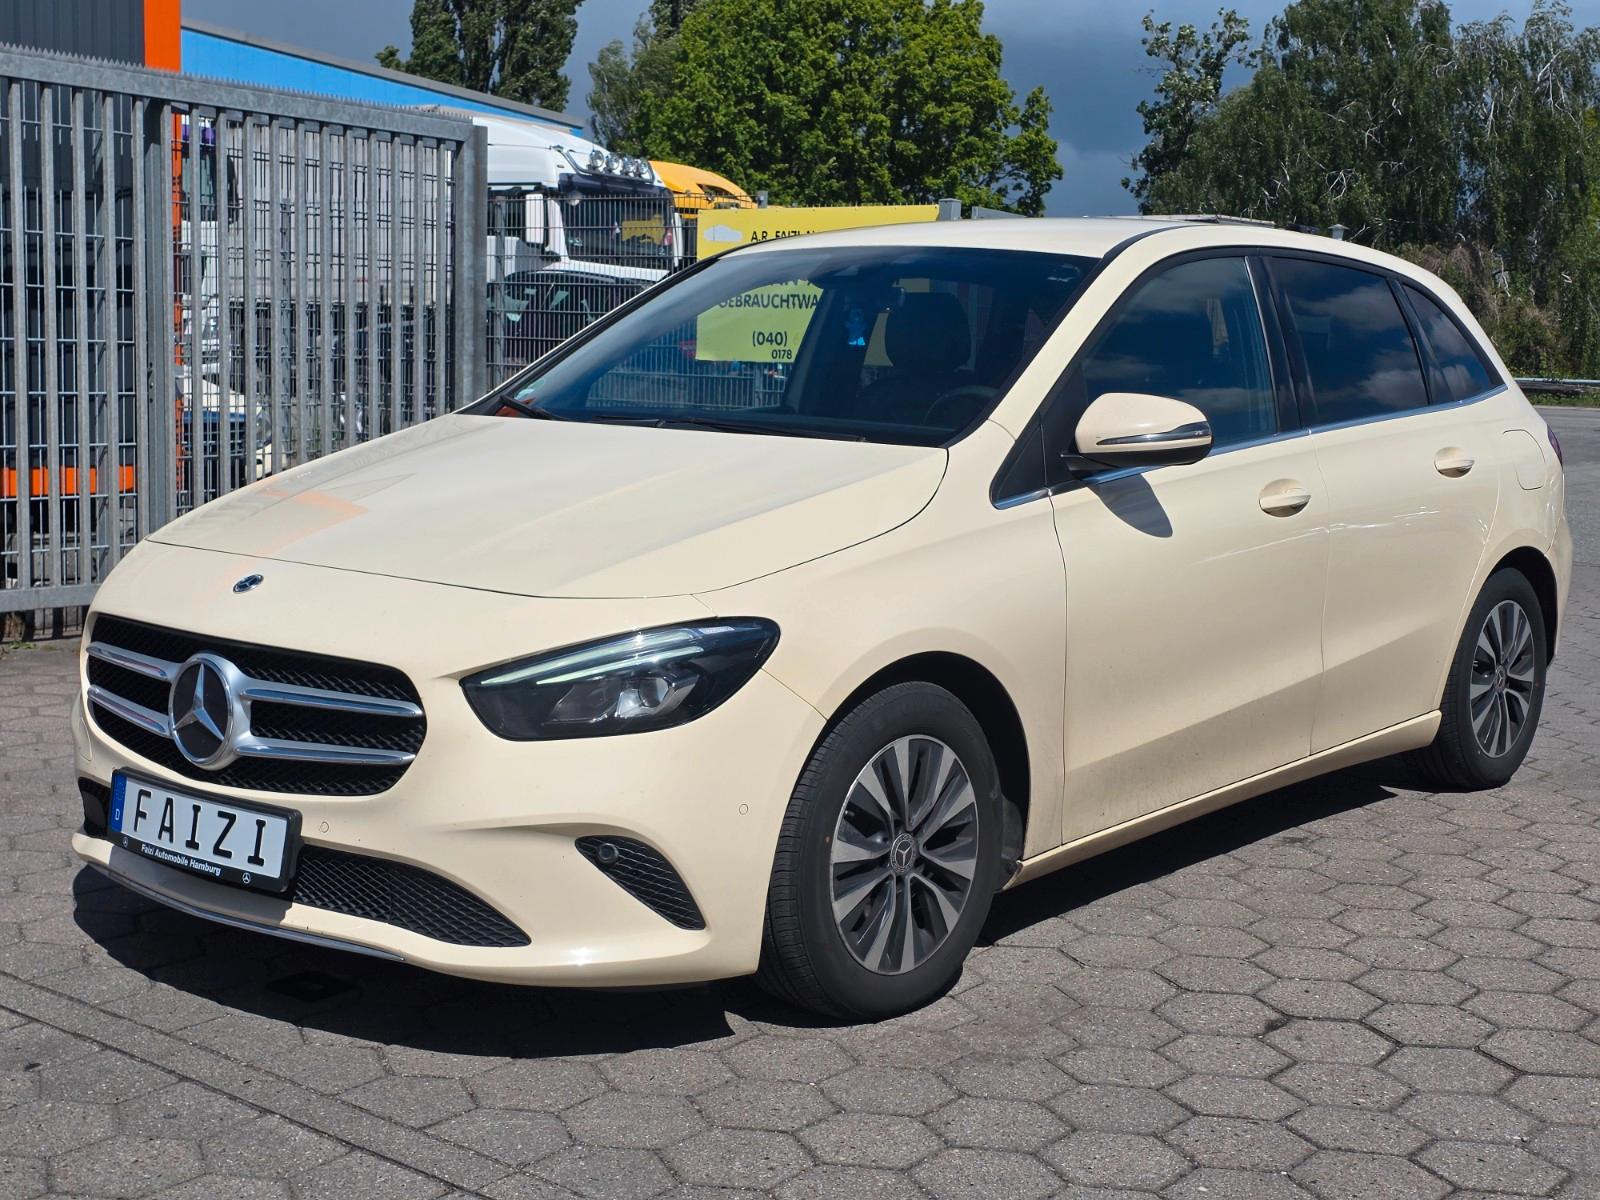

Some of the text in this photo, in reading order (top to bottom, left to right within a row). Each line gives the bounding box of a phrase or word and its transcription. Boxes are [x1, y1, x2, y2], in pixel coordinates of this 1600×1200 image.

[752, 330, 788, 348] (040)
[771, 348, 793, 360] 0178
[133, 788, 267, 867] FAIZI
[141, 844, 221, 877] Faizi Automobile Hamburg
